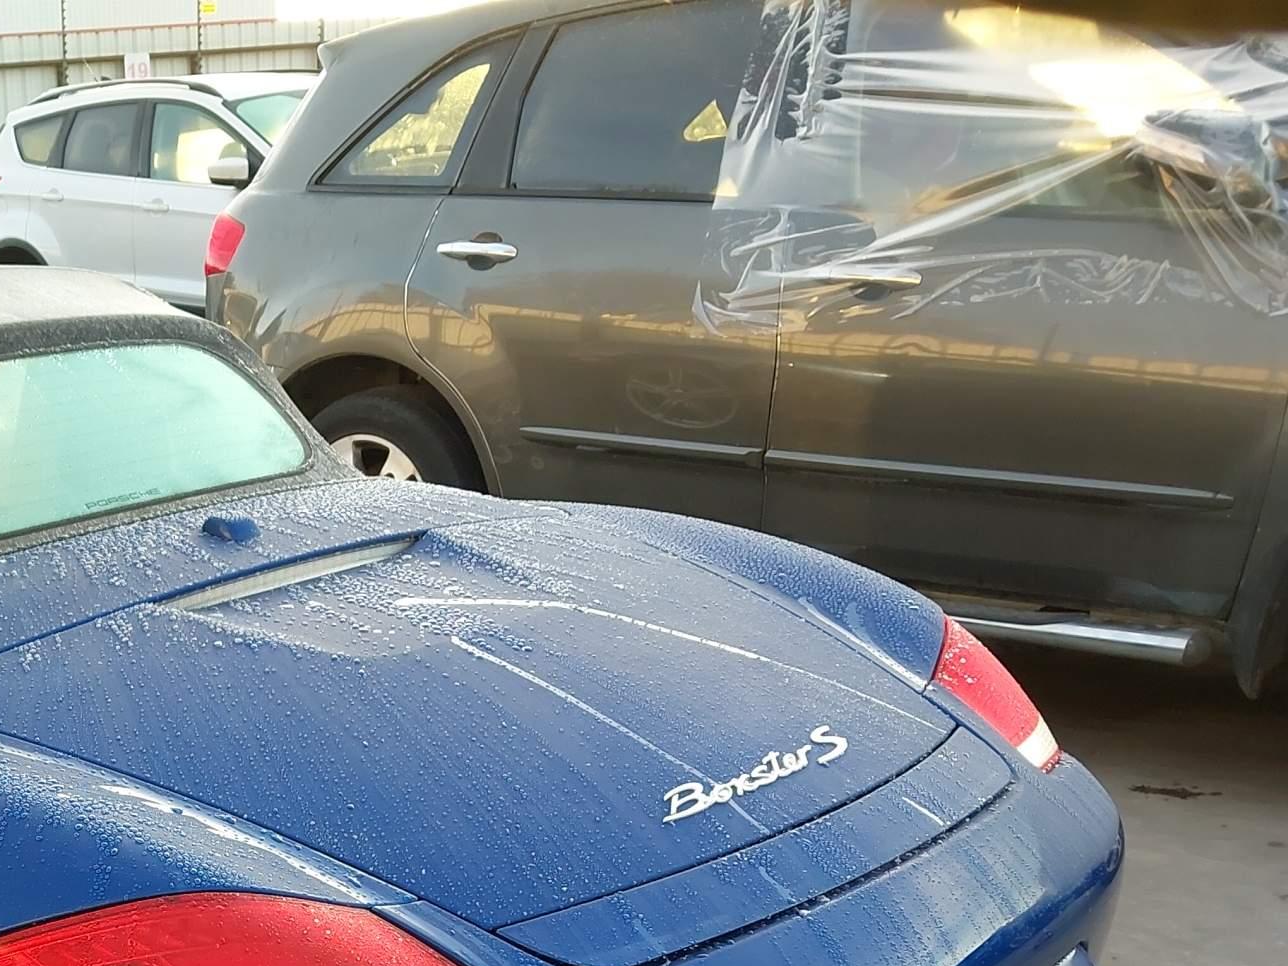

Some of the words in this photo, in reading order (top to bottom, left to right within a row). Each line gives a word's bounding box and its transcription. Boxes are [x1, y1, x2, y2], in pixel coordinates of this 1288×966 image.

[127, 62, 148, 79] 19
[84, 488, 161, 510] PORSCHE
[663, 744, 812, 823] Boxster
[810, 725, 848, 764] S
